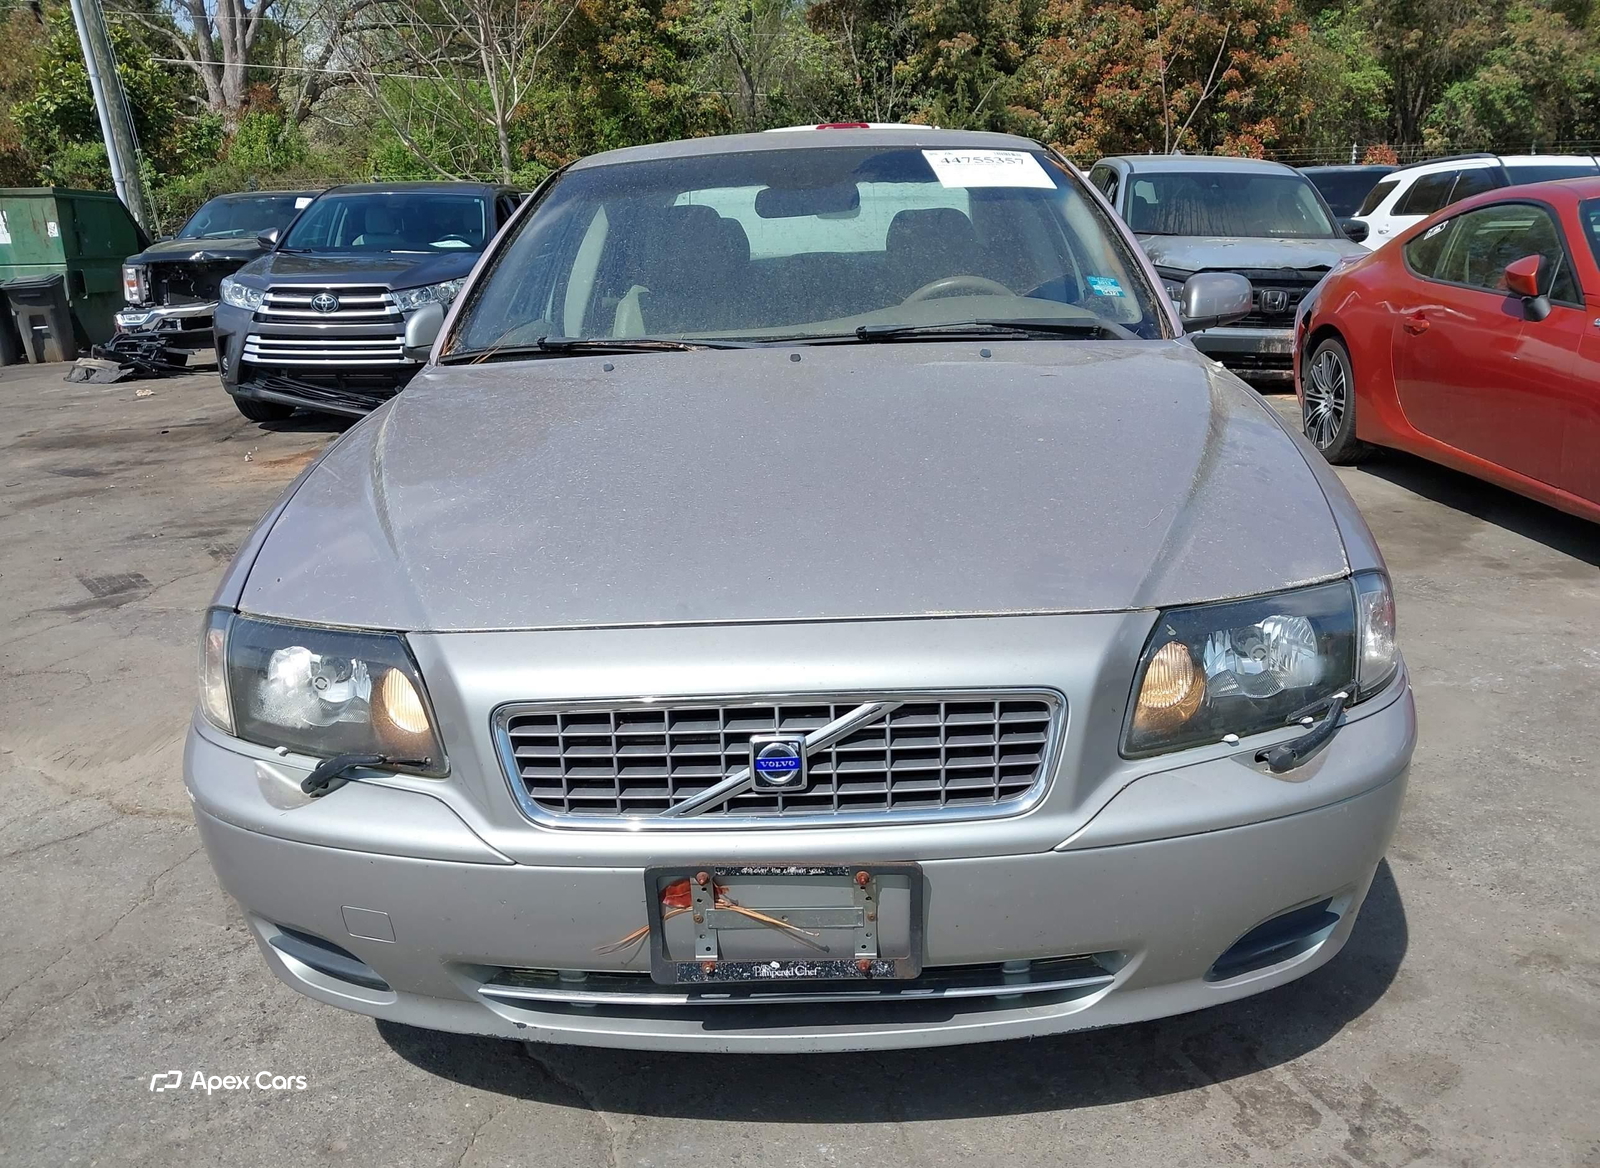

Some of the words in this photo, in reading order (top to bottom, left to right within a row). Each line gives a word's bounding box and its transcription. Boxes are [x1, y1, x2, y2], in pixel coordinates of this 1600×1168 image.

[940, 156, 1024, 165] 44755357
[759, 760, 796, 768] VOLVO
[752, 964, 793, 979] Pampered
[794, 964, 821, 976] Chef
